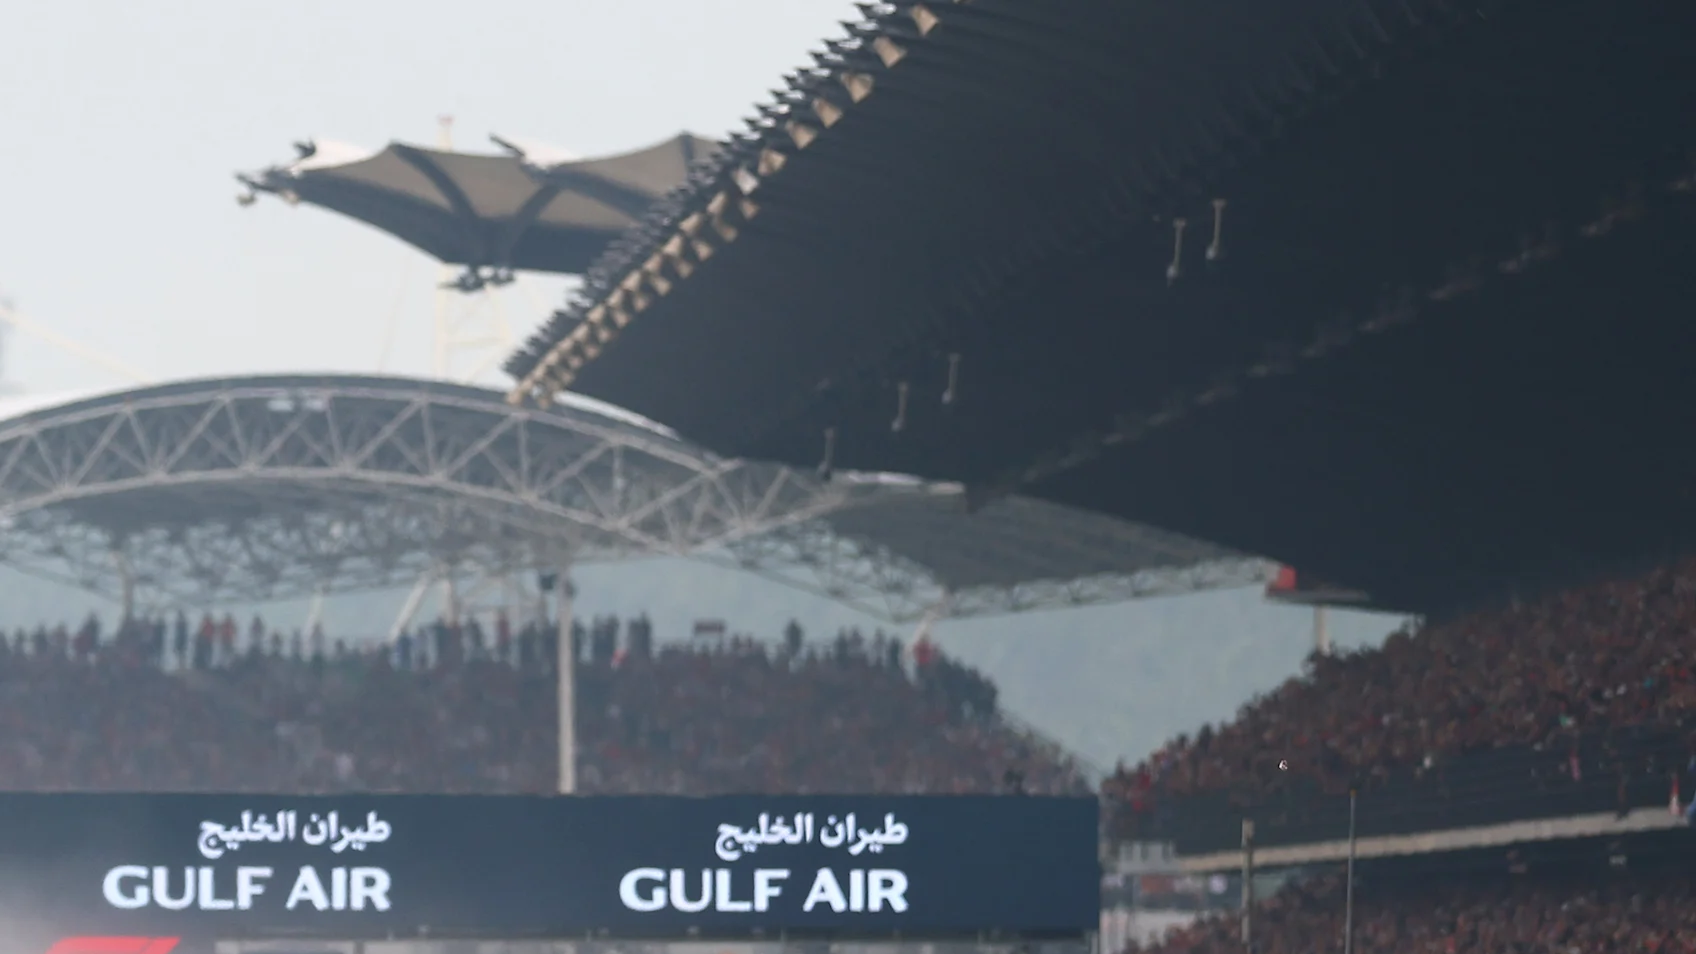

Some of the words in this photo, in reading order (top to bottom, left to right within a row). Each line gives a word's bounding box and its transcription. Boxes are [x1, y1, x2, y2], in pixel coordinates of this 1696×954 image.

[198, 808, 297, 859] الخليج
[302, 809, 392, 853] طيران
[715, 811, 814, 861] الخليج
[819, 811, 909, 856] طيران
[102, 864, 274, 911] GULF
[285, 864, 392, 911] AIR
[619, 866, 791, 913] GULF
[802, 866, 909, 913] AIR
